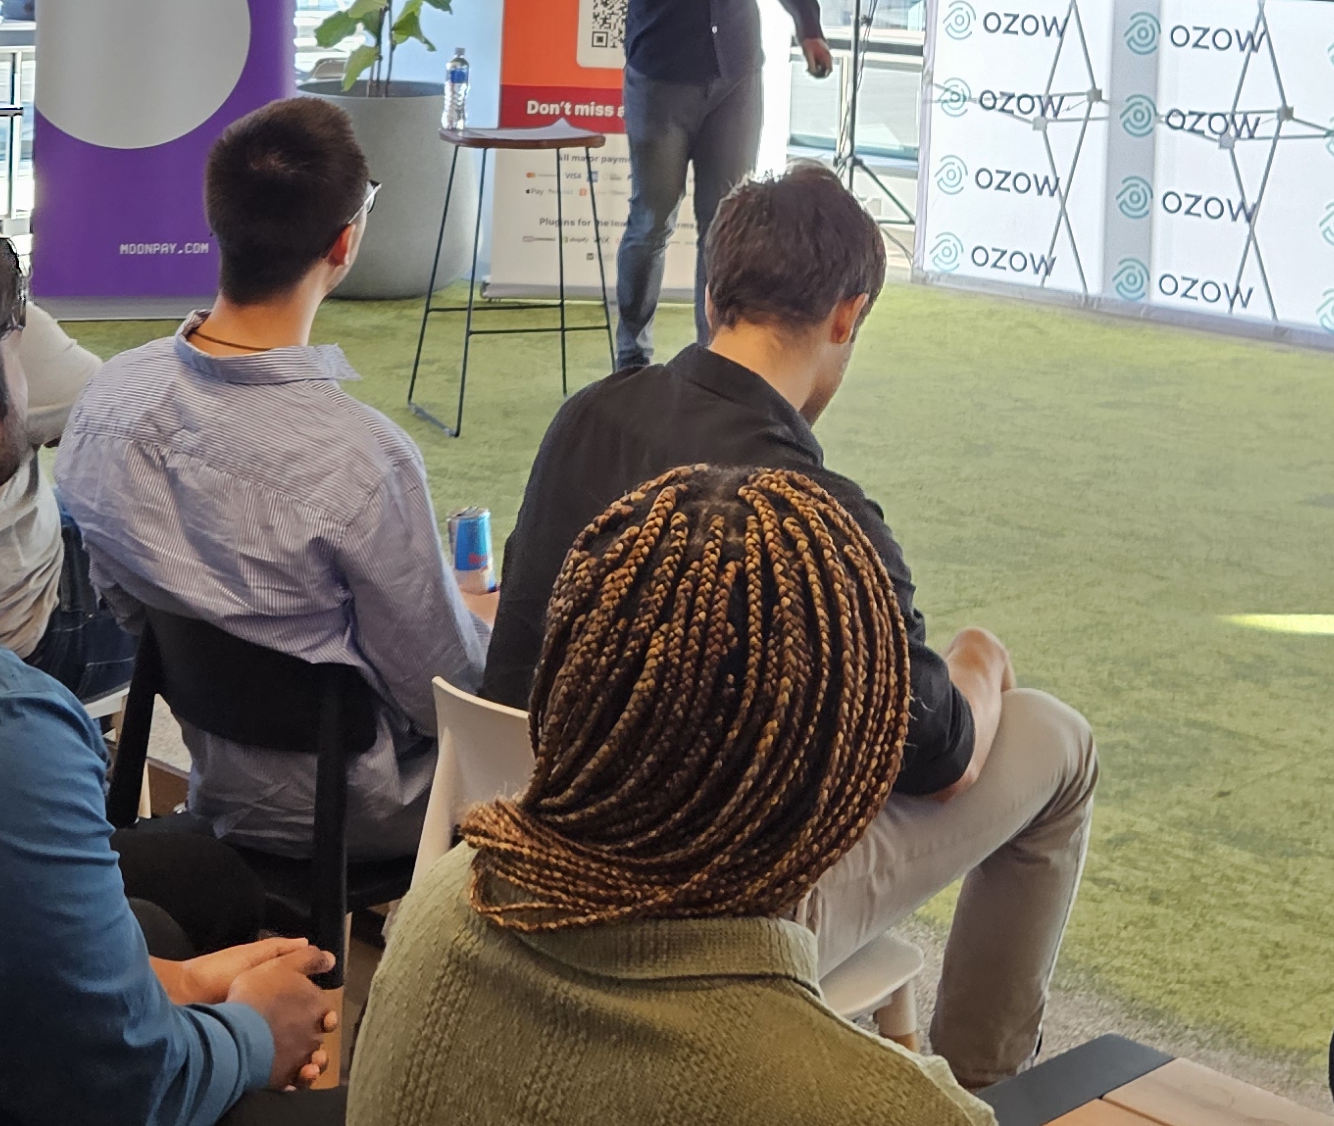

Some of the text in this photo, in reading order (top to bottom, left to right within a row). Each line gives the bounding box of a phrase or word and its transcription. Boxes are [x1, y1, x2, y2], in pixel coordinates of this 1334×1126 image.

[982, 11, 1068, 39] OZOW
[1169, 24, 1266, 54] OZOW
[526, 99, 572, 115] Don't
[574, 101, 615, 117] miss
[978, 89, 1065, 119] OZOW
[1164, 108, 1261, 139] OZOW
[974, 167, 1060, 198] OZOW
[577, 218, 591, 226] for
[1162, 190, 1258, 224] OZOW
[119, 242, 209, 255] MOONPAY.COM
[970, 245, 1057, 276] OZOW
[1158, 273, 1254, 309] OZOW
